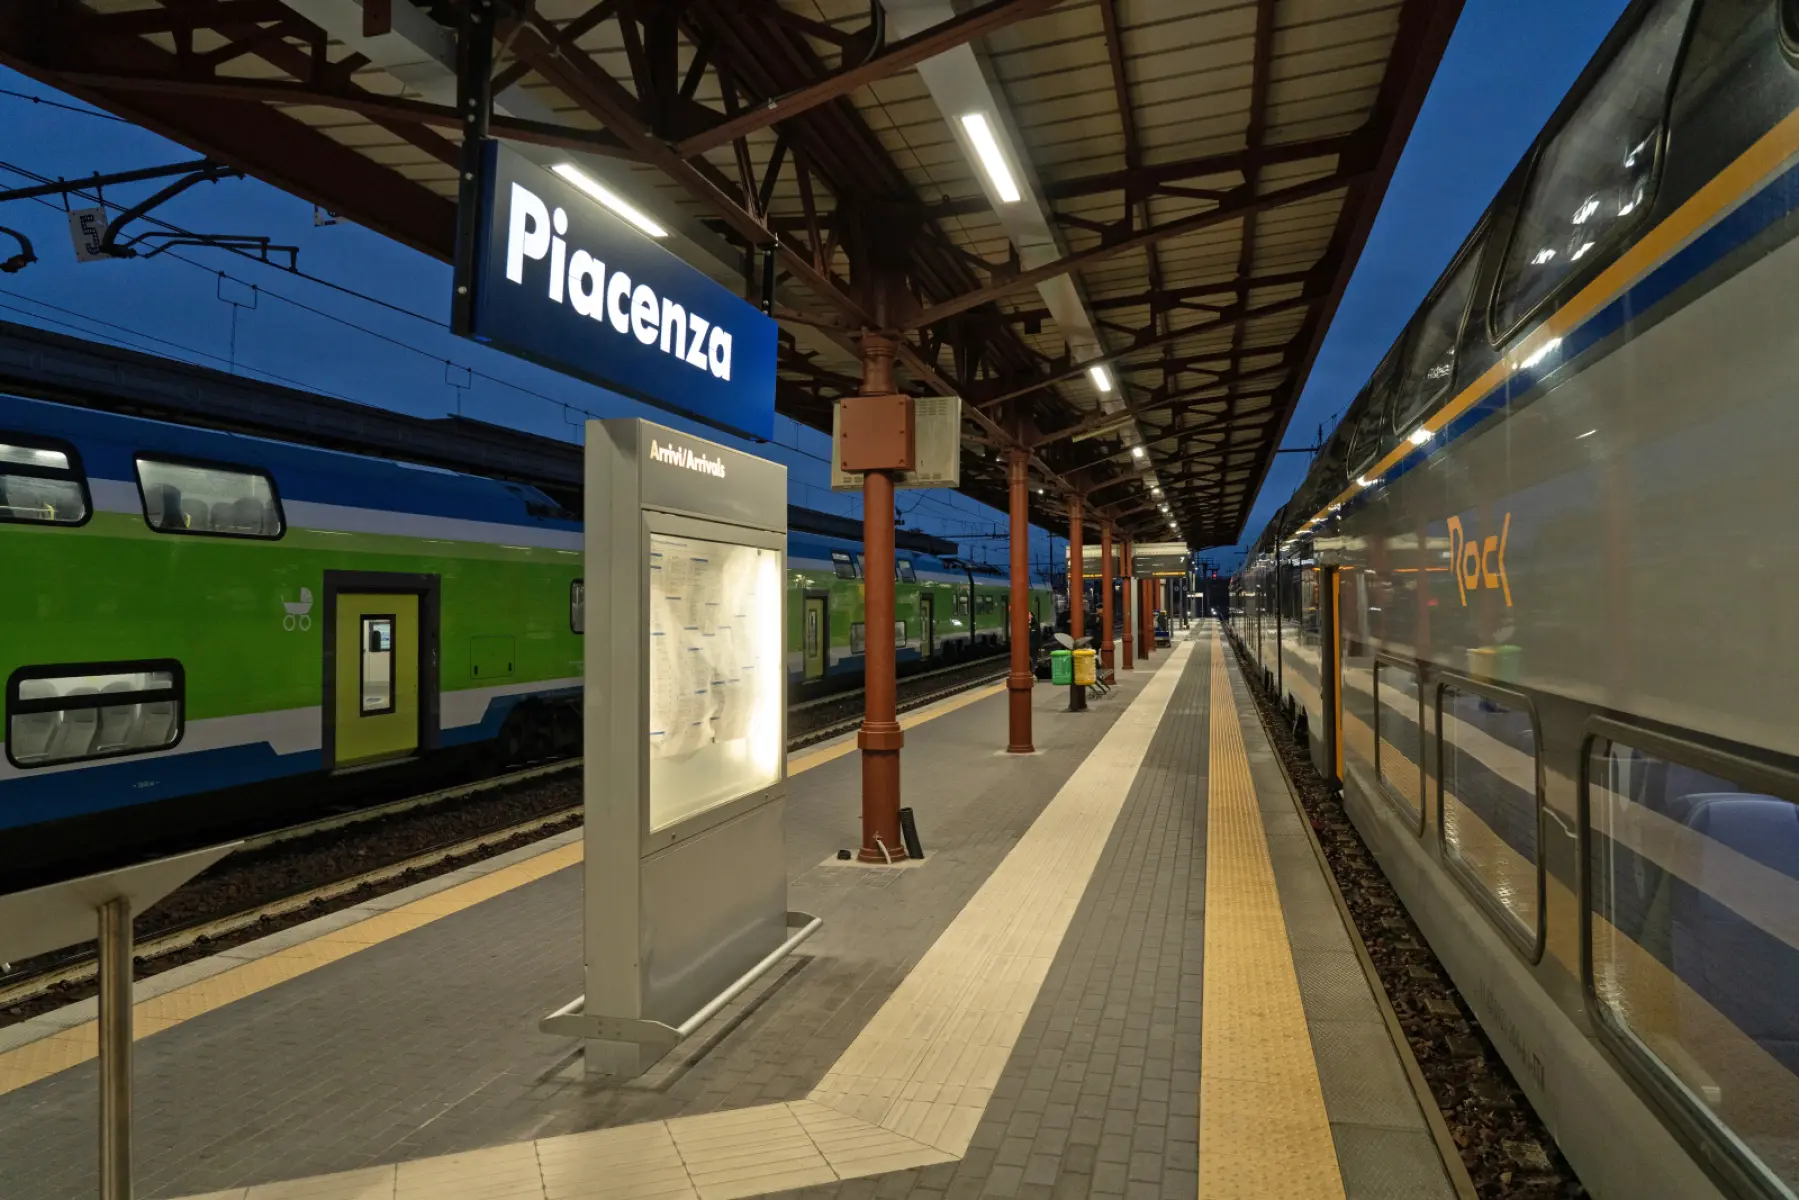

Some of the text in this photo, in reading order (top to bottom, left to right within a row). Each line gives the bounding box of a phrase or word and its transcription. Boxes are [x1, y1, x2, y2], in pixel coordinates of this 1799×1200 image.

[506, 181, 733, 382] Piacenza
[650, 439, 726, 478] Arrivi/Arrivals
[1447, 512, 1513, 607] Rock
